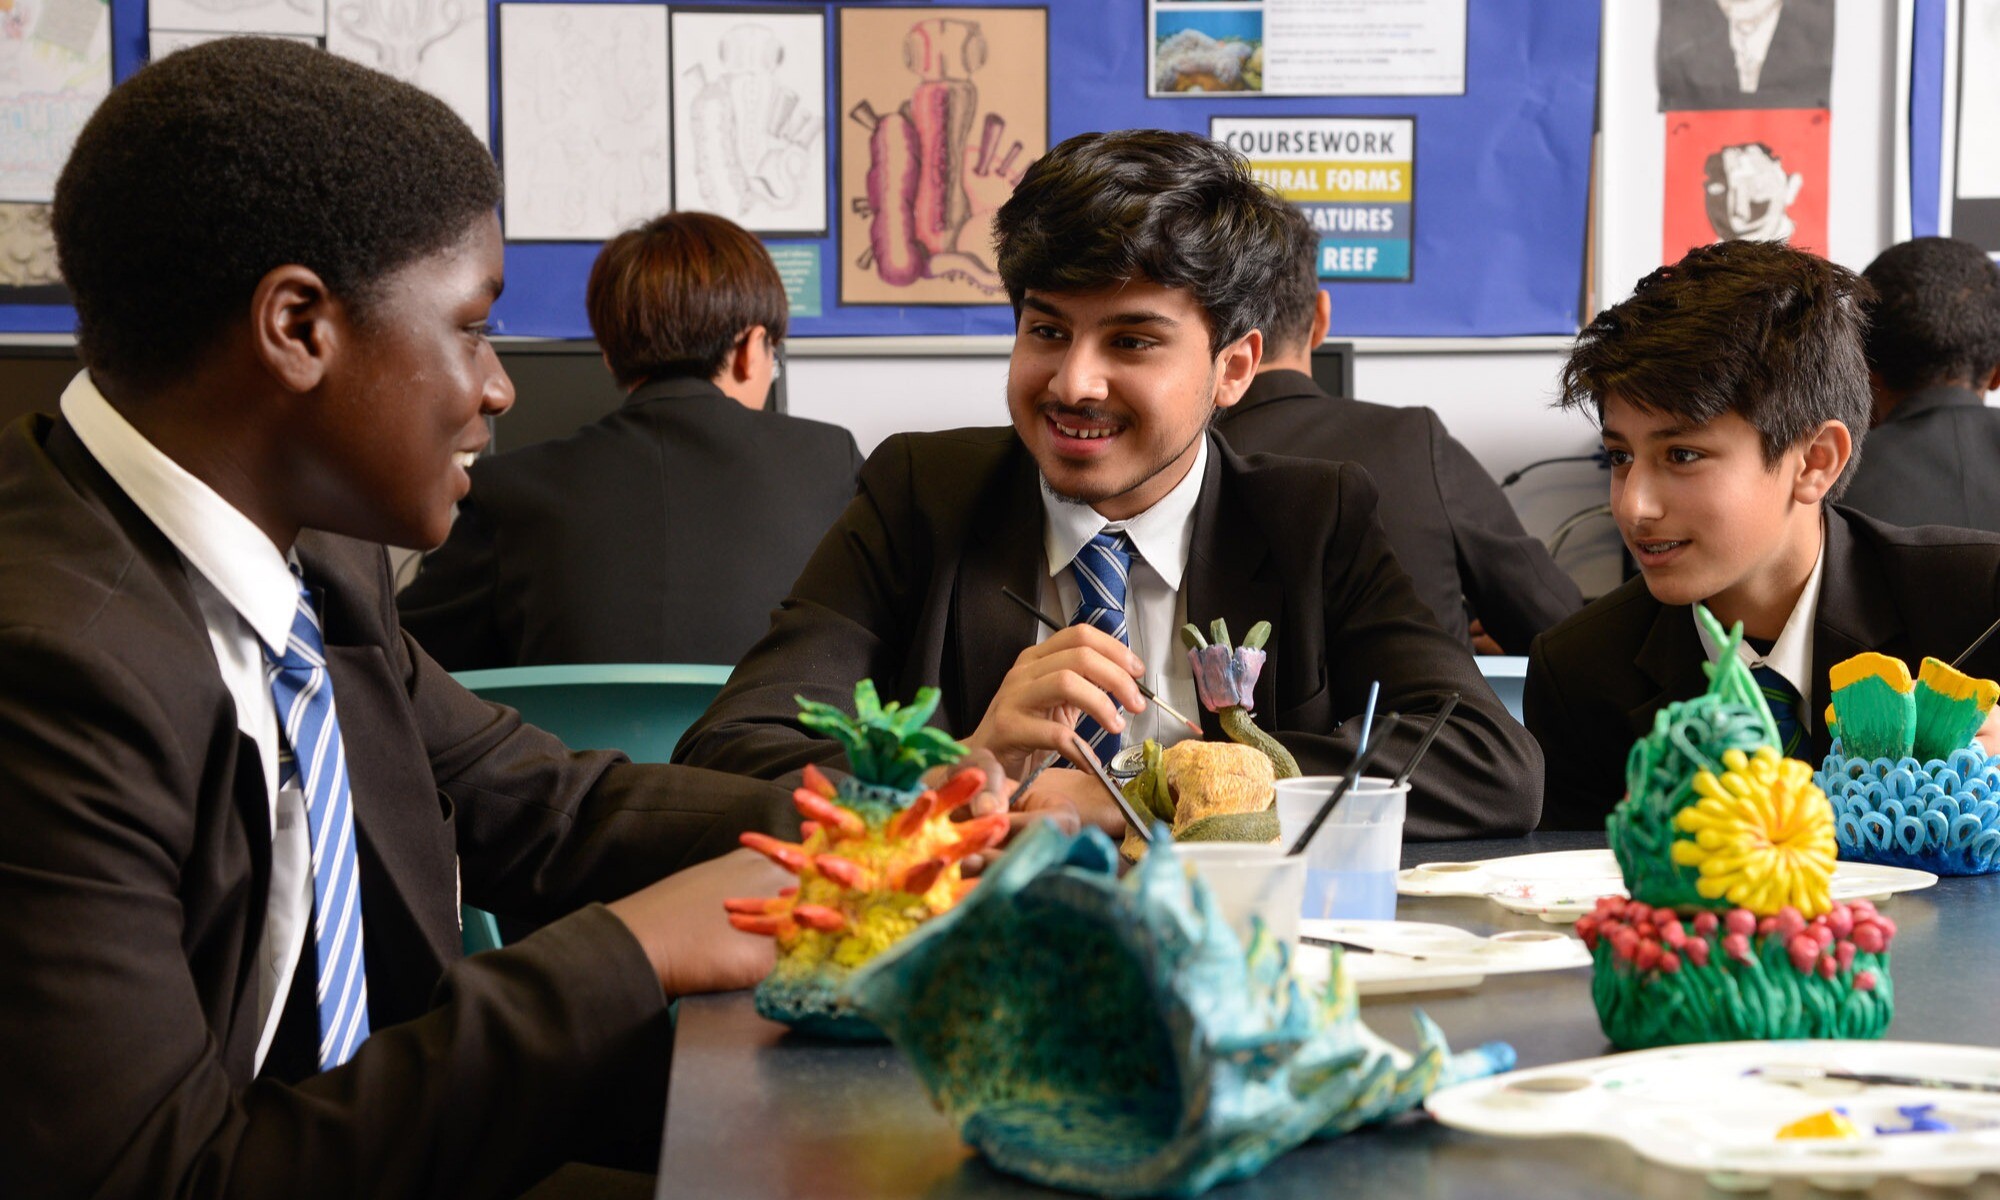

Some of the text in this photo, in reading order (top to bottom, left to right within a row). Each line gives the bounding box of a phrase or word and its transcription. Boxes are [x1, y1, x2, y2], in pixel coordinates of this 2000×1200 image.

[1226, 131, 1394, 153] COURSEWORK
[1250, 169, 1402, 192] TURAL FORMS
[1323, 247, 1379, 271] REEF
